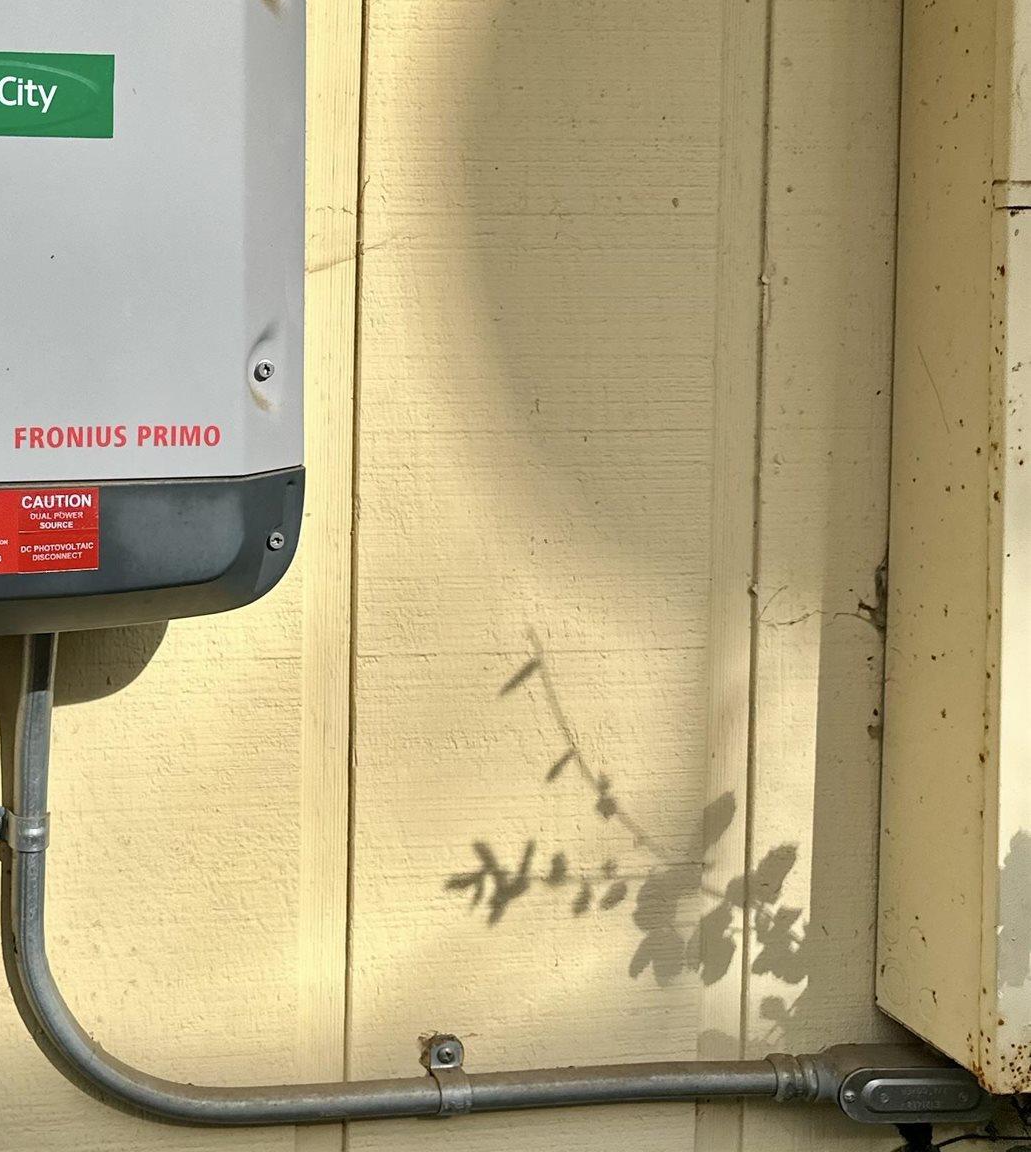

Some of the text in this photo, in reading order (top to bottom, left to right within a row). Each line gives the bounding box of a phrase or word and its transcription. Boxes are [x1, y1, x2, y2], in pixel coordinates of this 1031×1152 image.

[14, 425, 220, 448] FRONIUS PRIMO
[22, 494, 91, 508] CAUTION
[34, 542, 93, 552] PHOTOVOLTAIC
[32, 552, 82, 561] DISCONNECT
